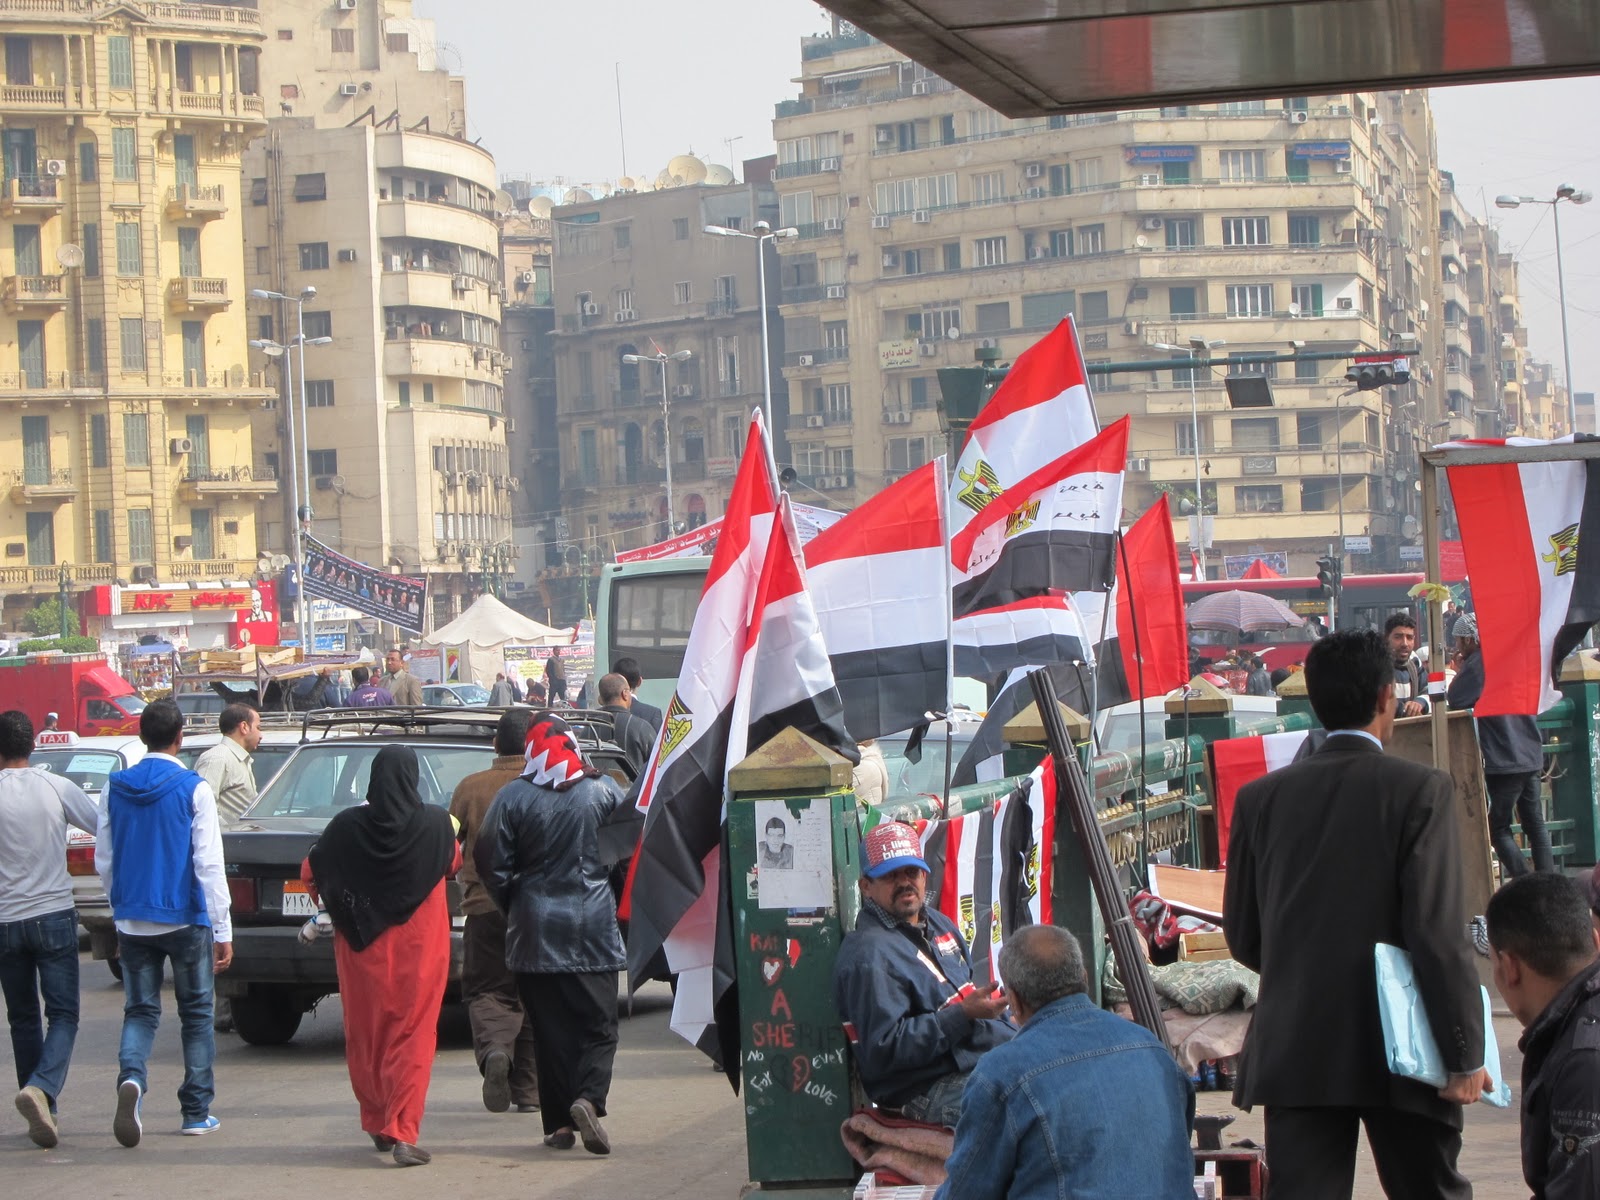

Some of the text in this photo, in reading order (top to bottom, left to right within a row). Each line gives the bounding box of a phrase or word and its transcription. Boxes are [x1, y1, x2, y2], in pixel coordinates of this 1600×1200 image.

[133, 593, 174, 611] KFC
[42, 734, 68, 744] TAXI
[771, 988, 792, 1021] A
[804, 1080, 838, 1106] LOVE
